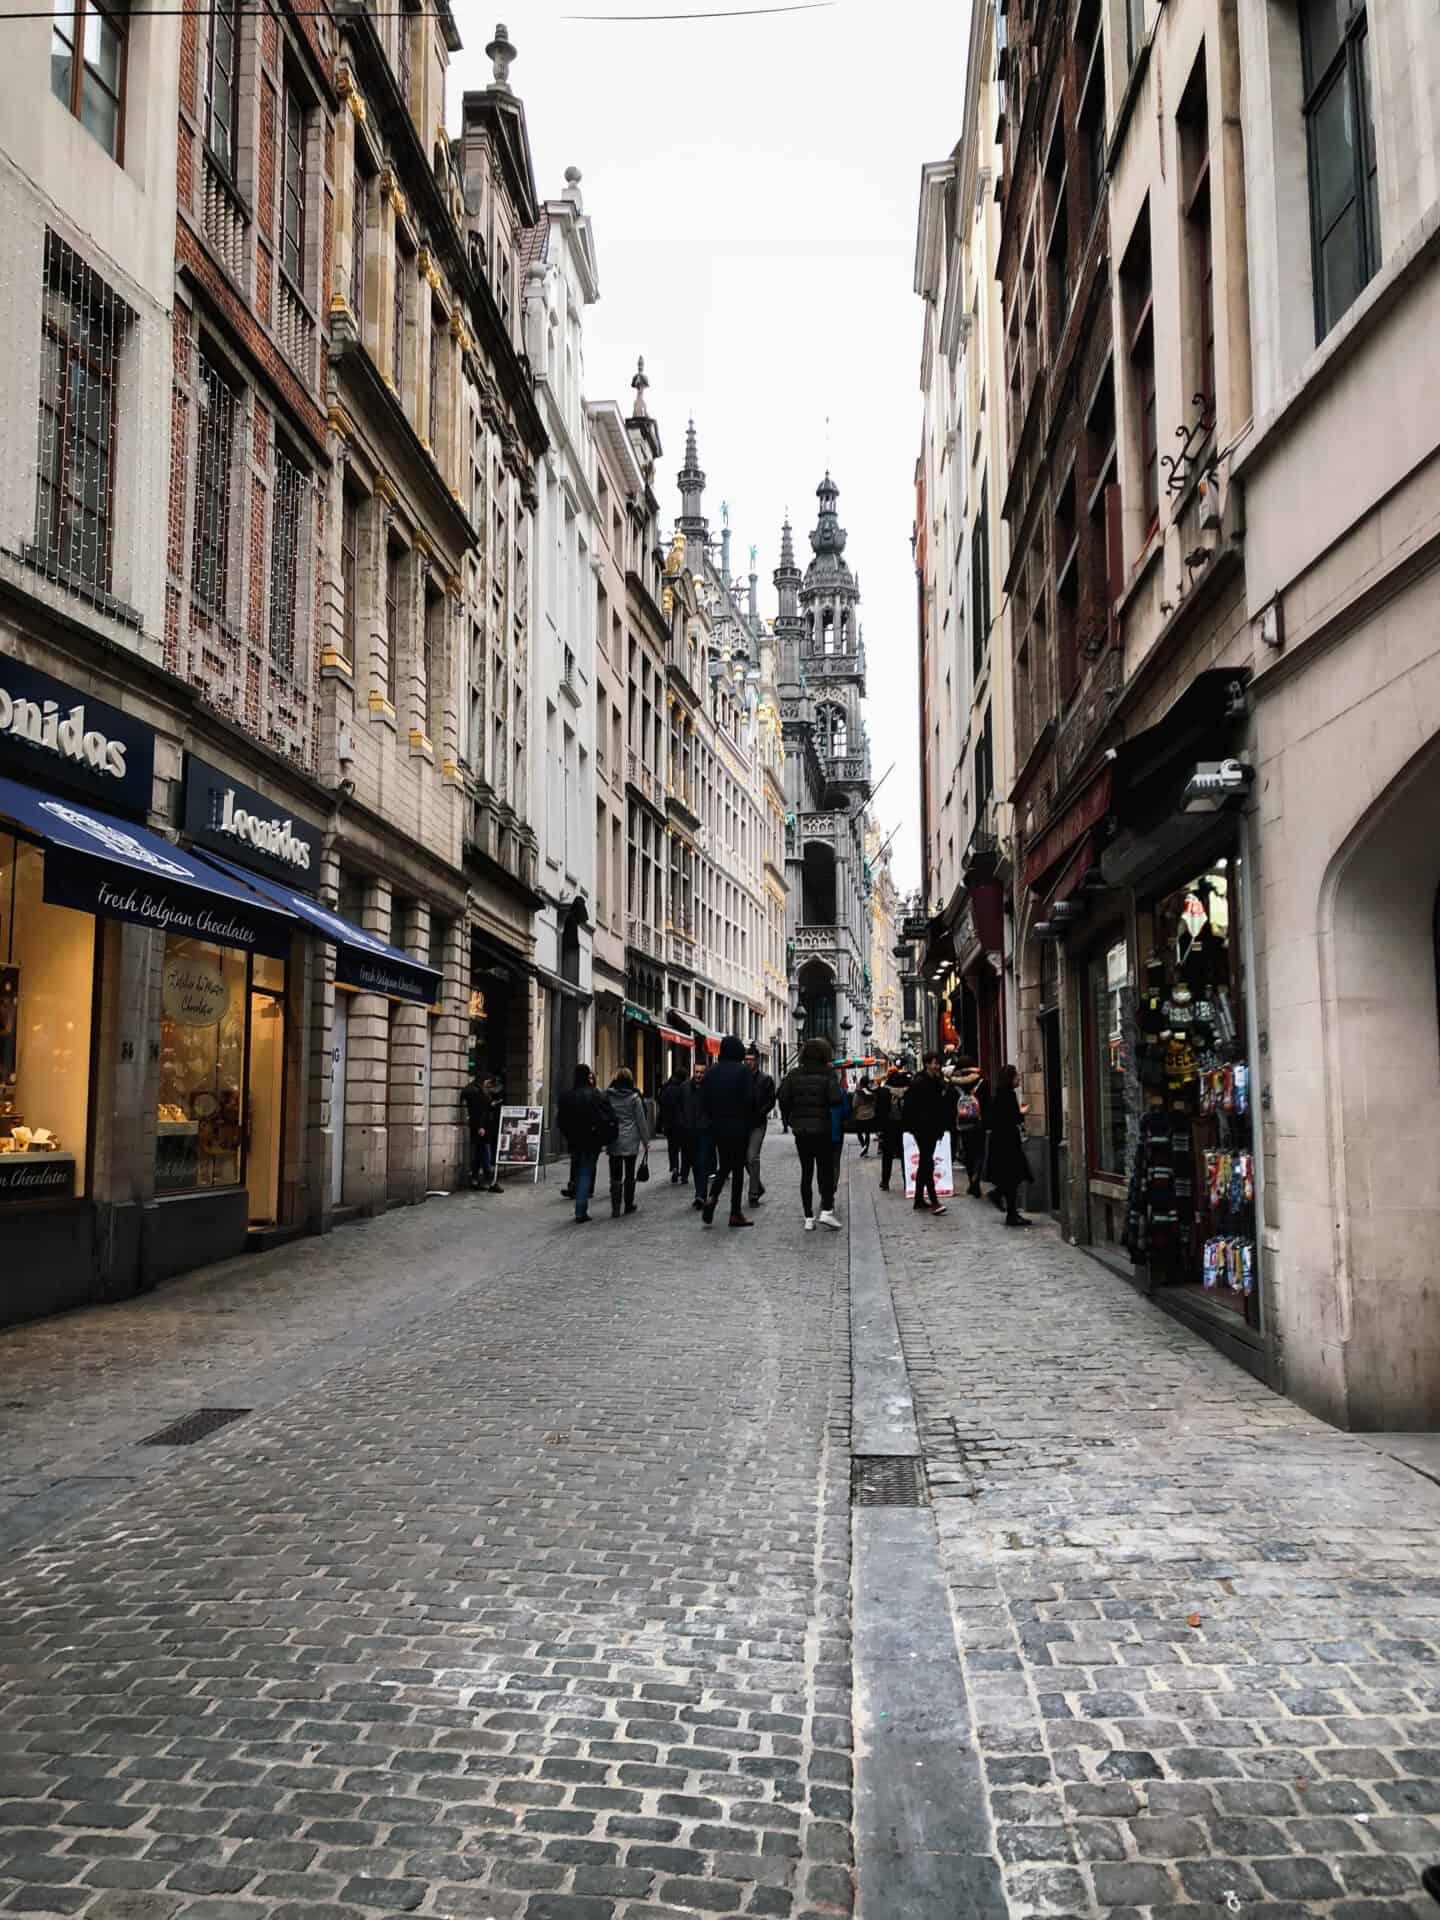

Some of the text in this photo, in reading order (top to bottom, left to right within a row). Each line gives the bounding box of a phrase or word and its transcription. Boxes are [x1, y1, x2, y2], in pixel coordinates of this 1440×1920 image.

[221, 788, 310, 870] Leonidas
[97, 881, 138, 912] Fresh
[140, 894, 194, 928] Belgian
[196, 911, 256, 943] Chocolates
